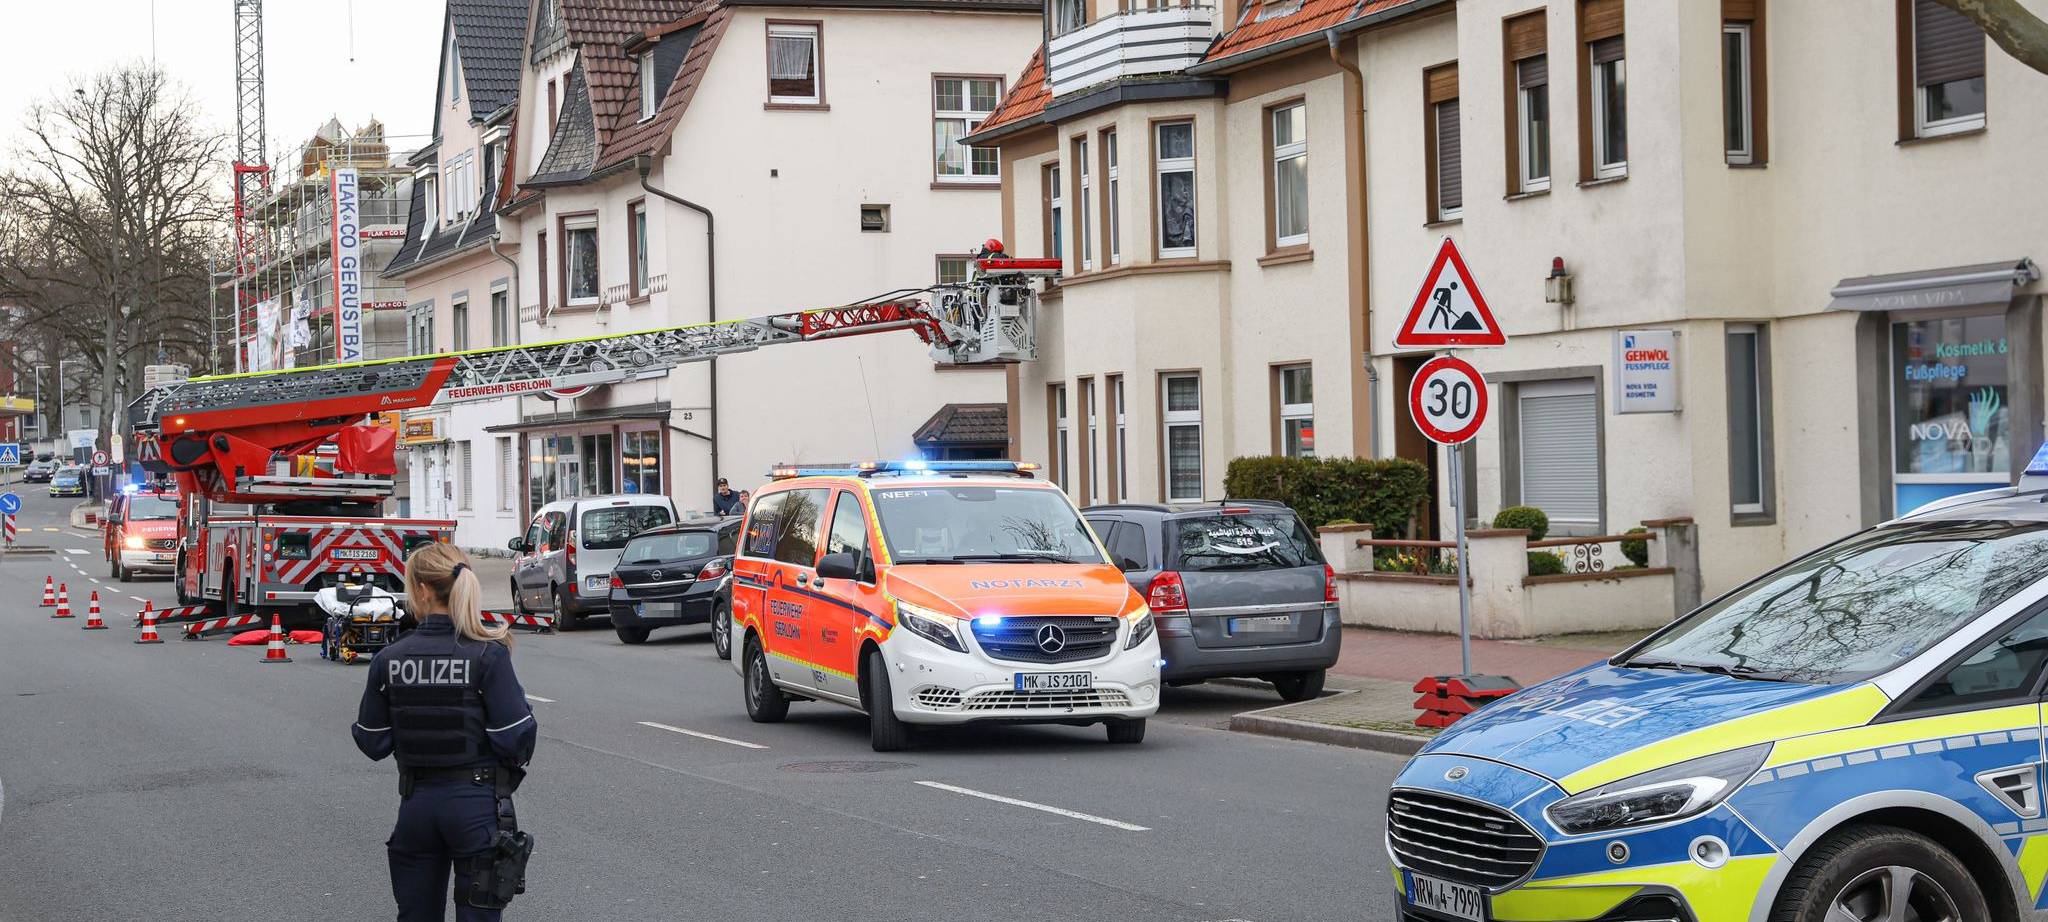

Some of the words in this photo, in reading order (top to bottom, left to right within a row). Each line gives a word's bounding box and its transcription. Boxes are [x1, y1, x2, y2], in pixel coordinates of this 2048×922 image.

[340, 256, 360, 360] GERÜSTBA
[1625, 349, 1670, 362] GEHWOL
[1936, 339, 1996, 358] Kosmetik
[1998, 338, 2008, 353] &
[1625, 362, 1671, 370] FUSSPFLEGE
[1905, 363, 1967, 382] Fußpflege
[448, 384, 504, 399] FEUERWEHR
[506, 379, 552, 393] ISERLOHN
[1427, 378, 1472, 419] 30
[1910, 421, 1973, 441] NOVA
[881, 490, 928, 499] NEF-1
[1236, 537, 1254, 546] 515
[353, 550, 360, 558] IS
[361, 550, 377, 558] 2168
[971, 579, 1085, 589] NOTARZT
[770, 599, 804, 619] FEUERWEHR
[775, 620, 802, 640] ISERLOHN
[388, 659, 471, 684] POLIZEI
[1024, 675, 1038, 688] MK
[1047, 675, 1060, 688] IS
[1062, 674, 1089, 687] 2101
[1412, 876, 1434, 906] NRW
